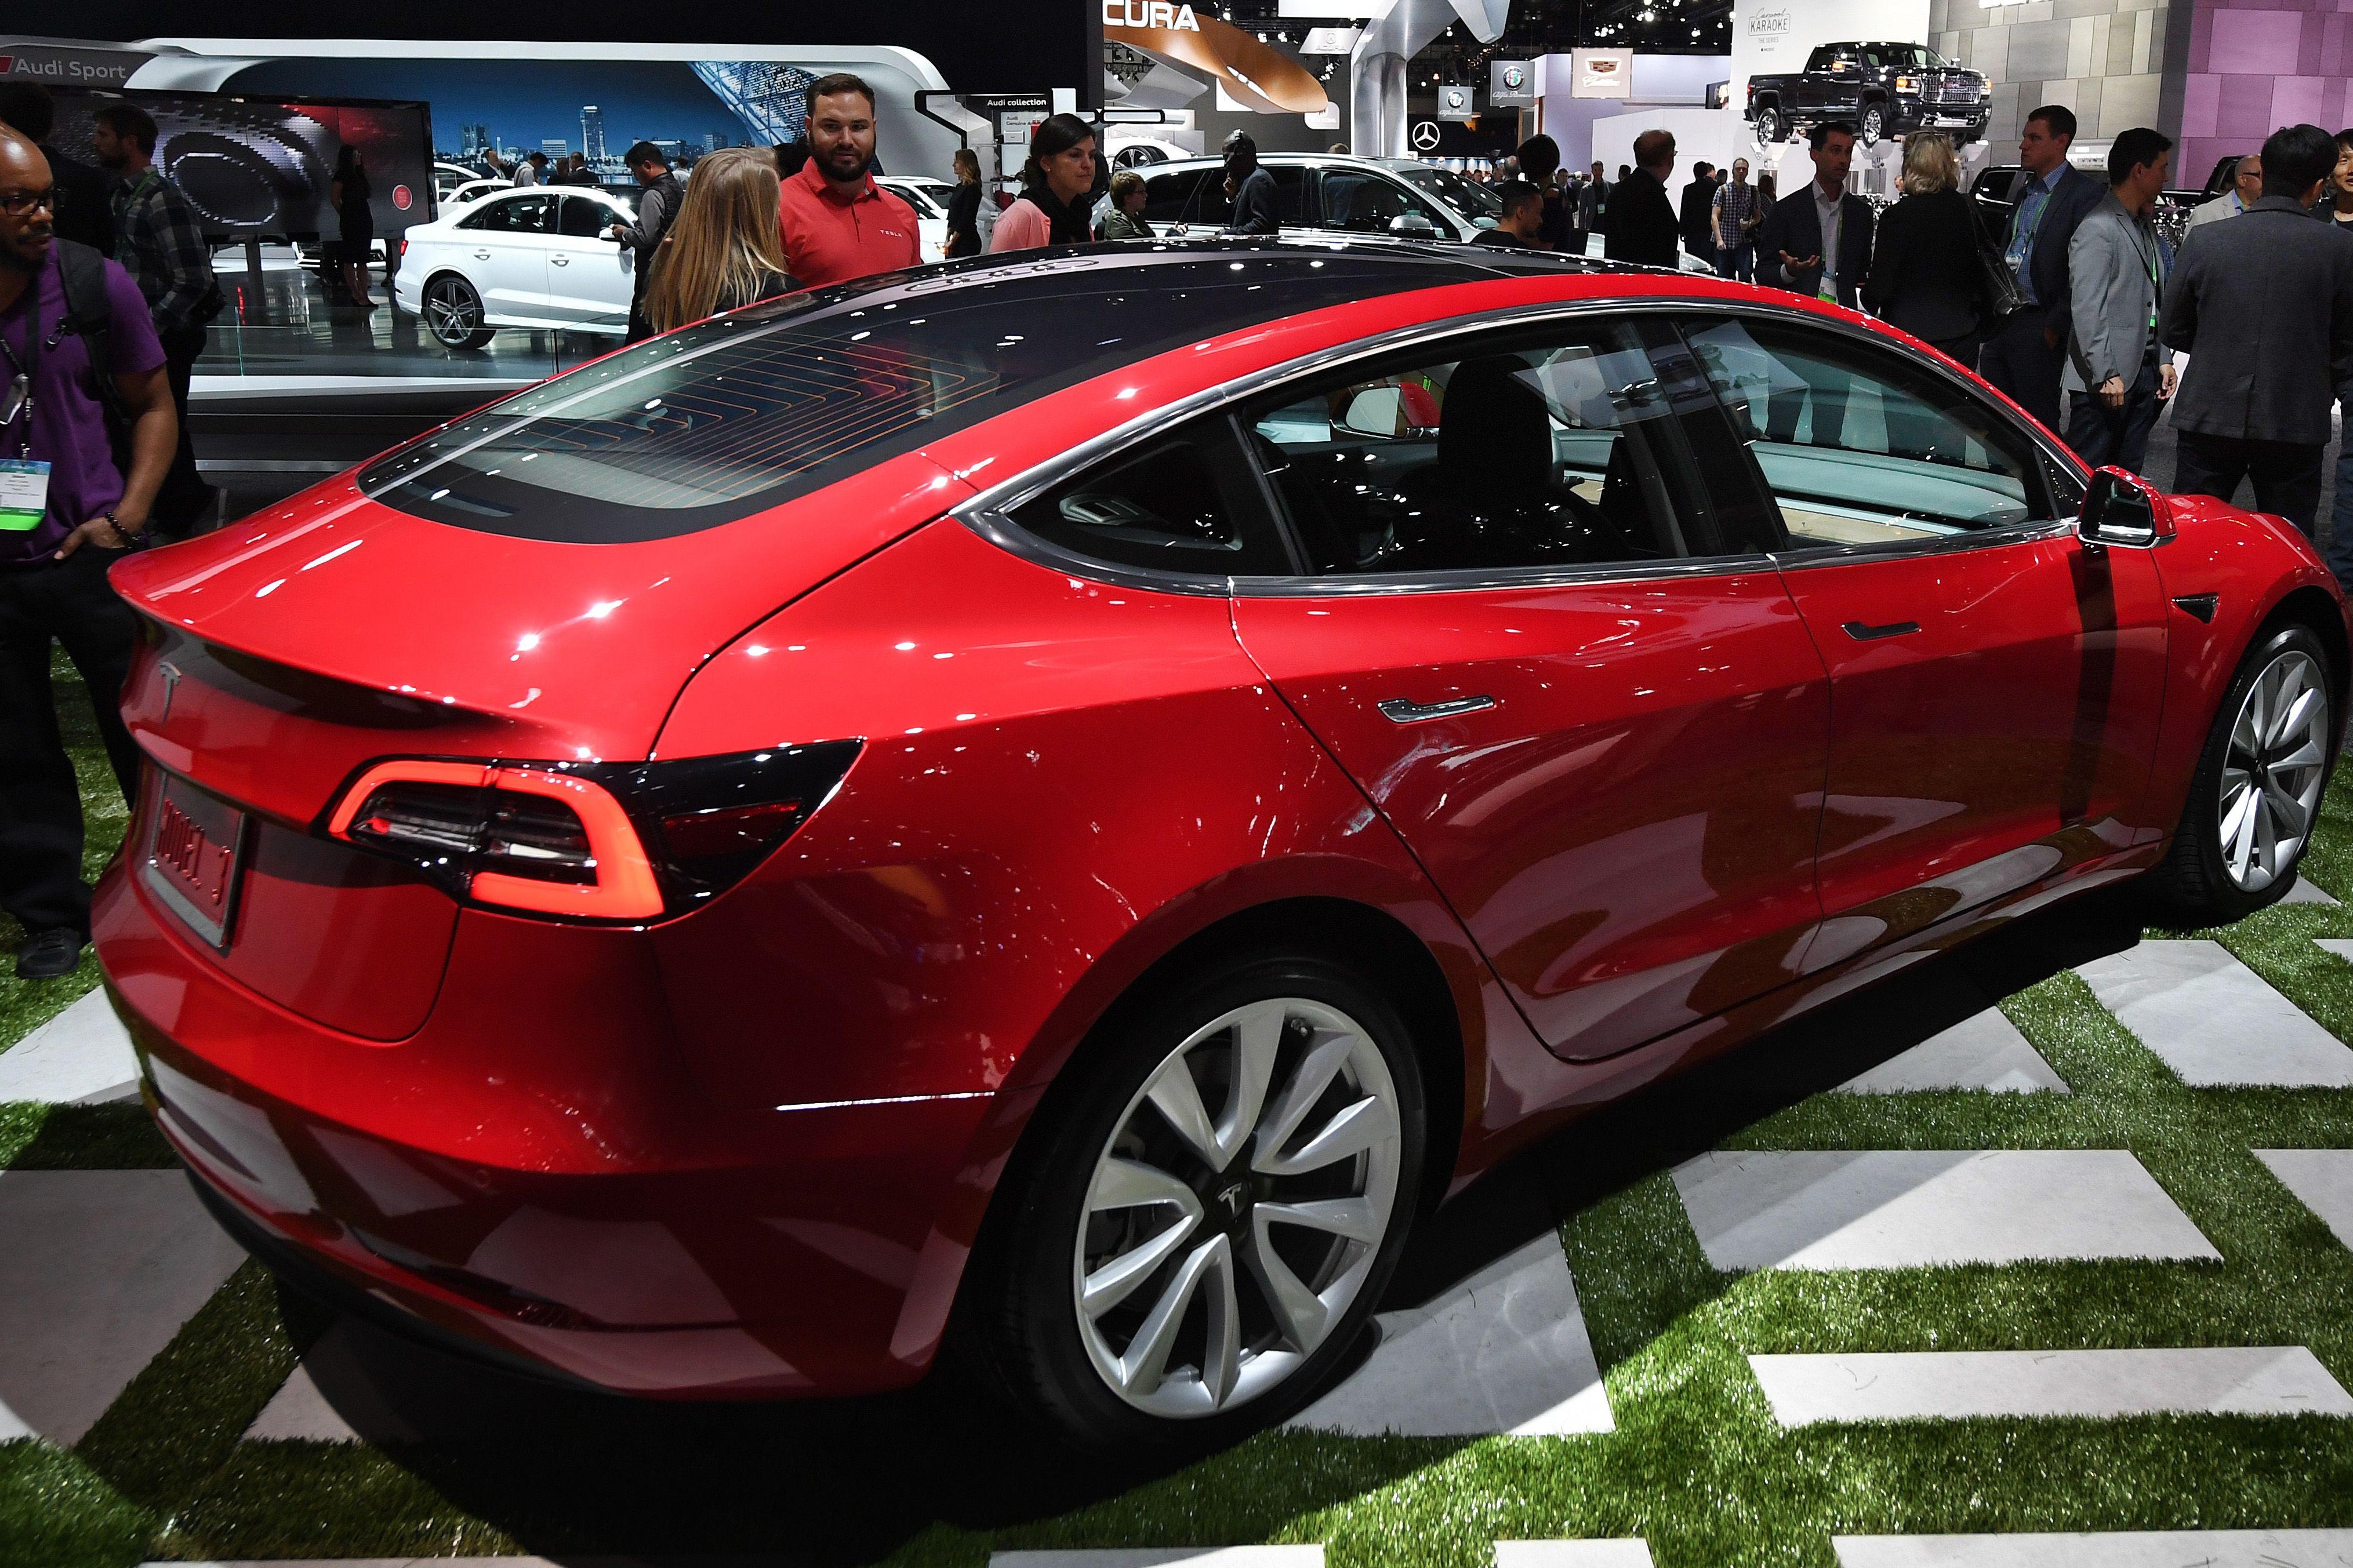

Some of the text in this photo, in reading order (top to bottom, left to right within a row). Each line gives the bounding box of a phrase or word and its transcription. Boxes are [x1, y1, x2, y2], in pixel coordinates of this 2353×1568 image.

[1751, 18, 1788, 32] KARAOKE
[15, 59, 126, 80] Audi Sport
